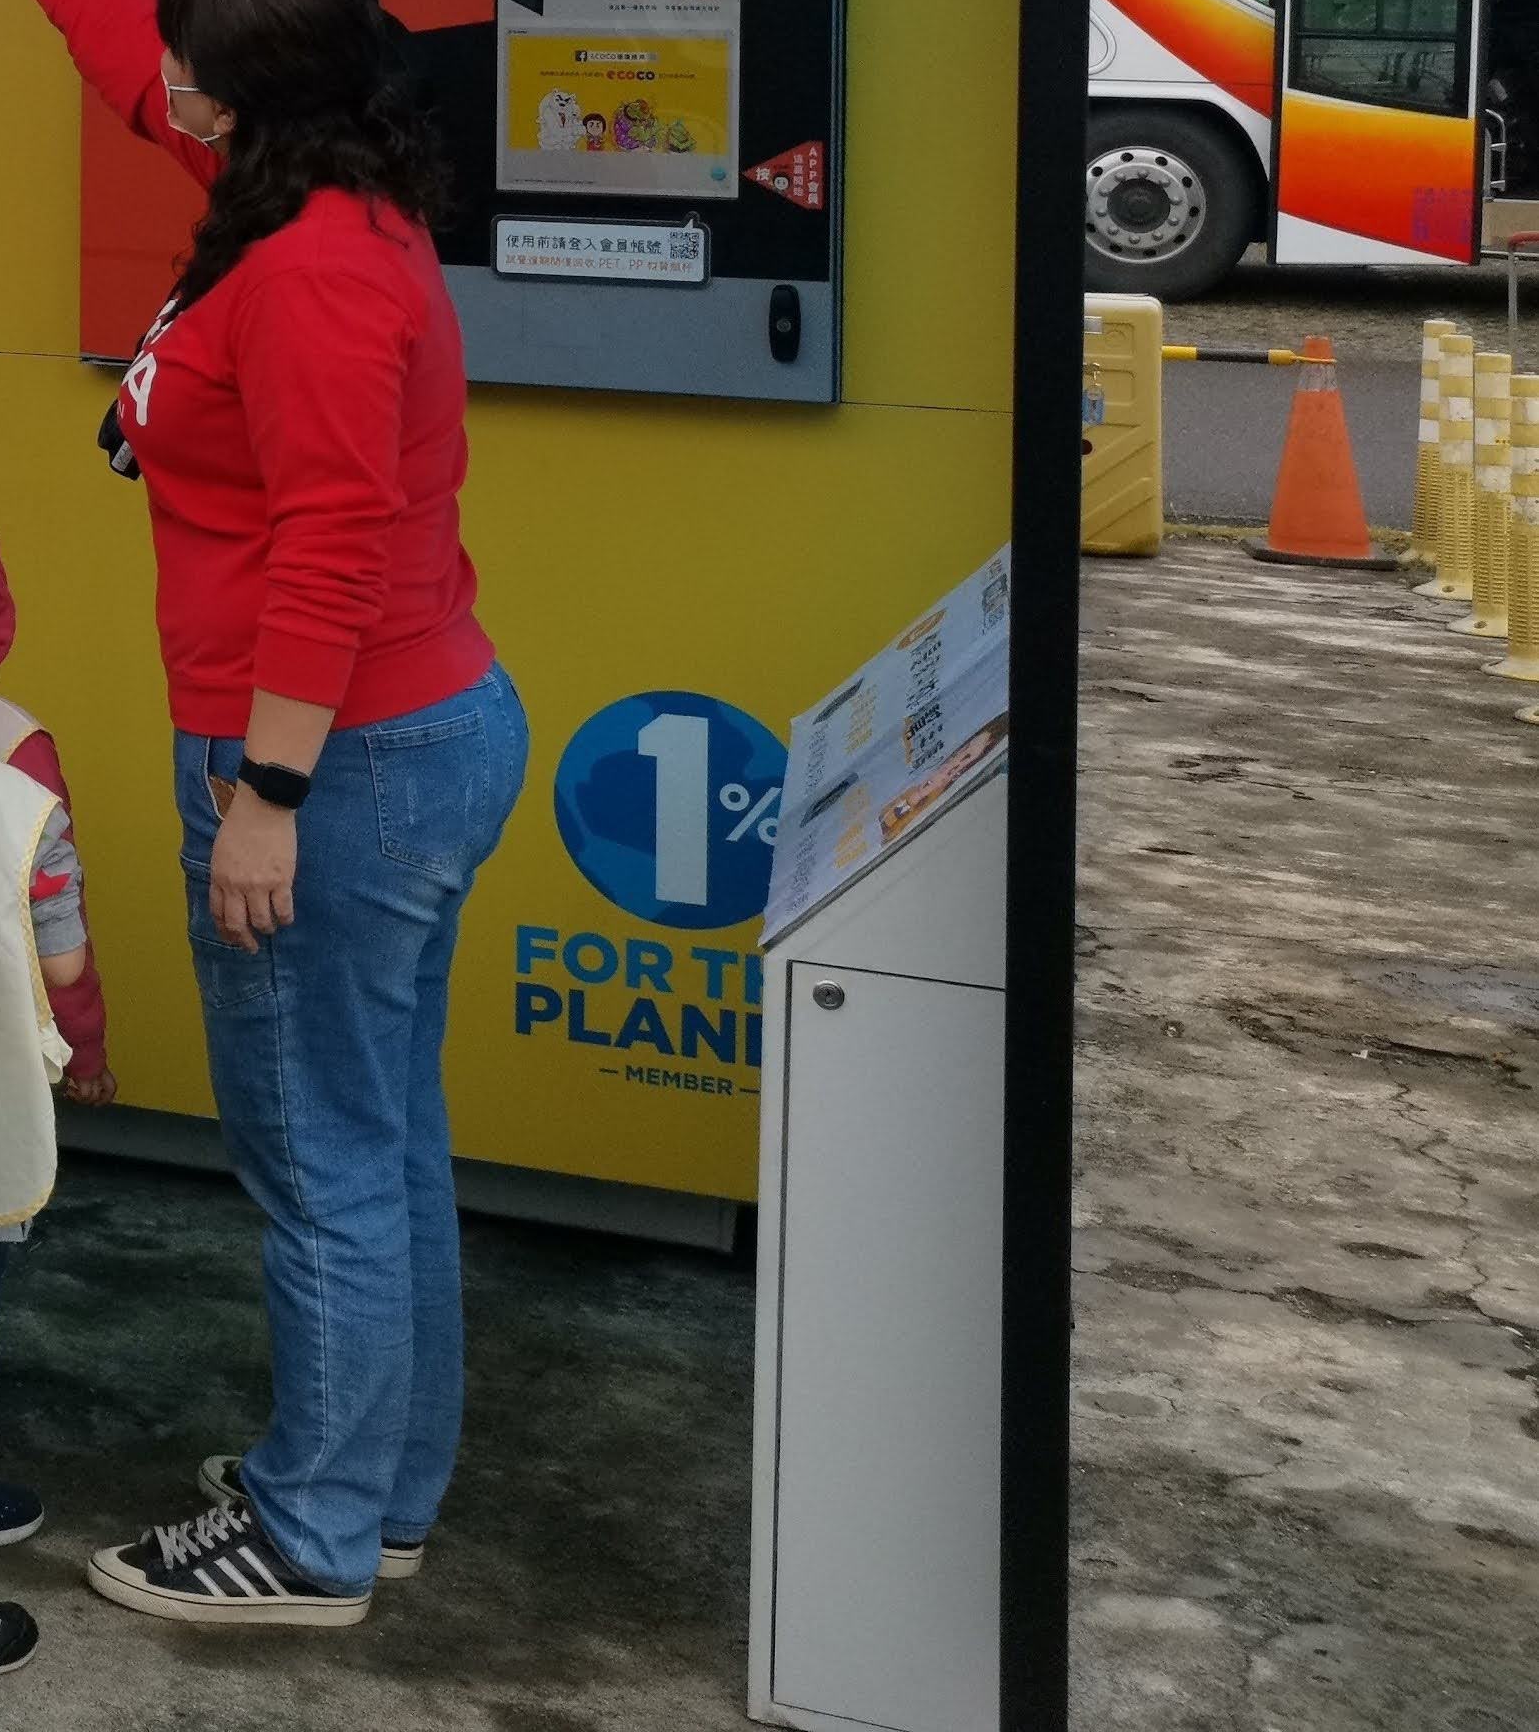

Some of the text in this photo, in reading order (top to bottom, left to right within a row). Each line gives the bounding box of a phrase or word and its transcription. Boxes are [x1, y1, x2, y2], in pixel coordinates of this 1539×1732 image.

[505, 233, 662, 254] 使用前請登入會員帳號
[515, 924, 674, 993] FOR
[625, 1064, 734, 1096] MEMBER
